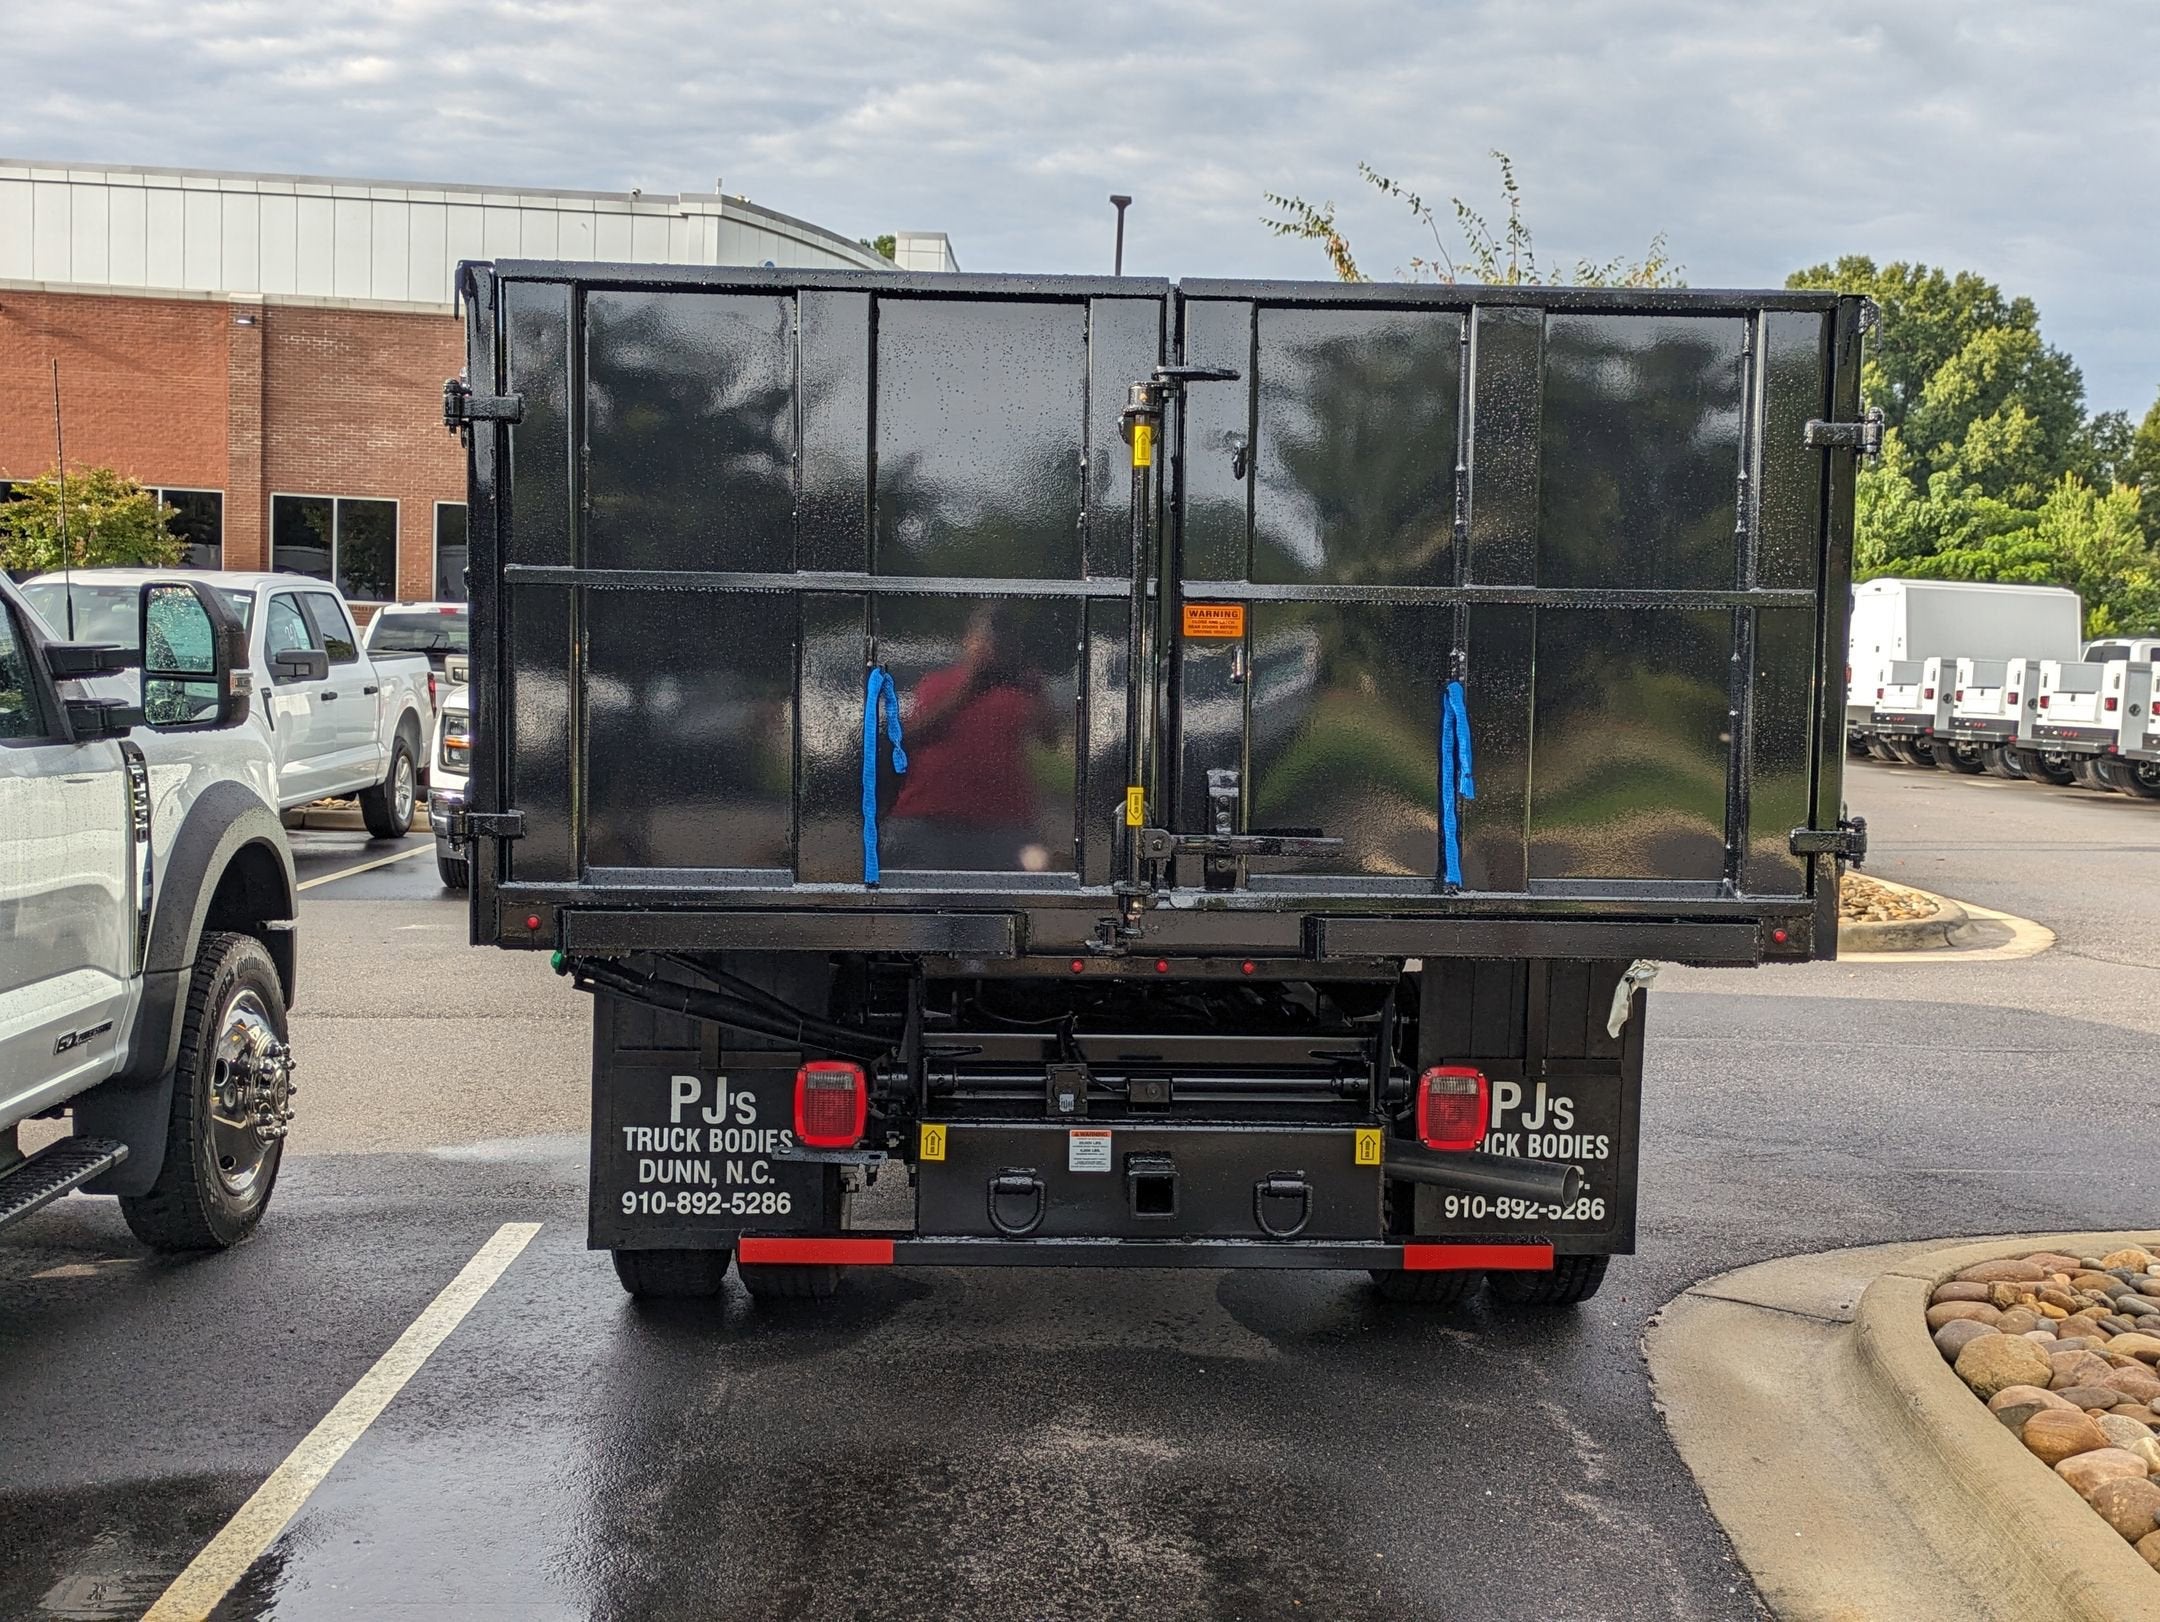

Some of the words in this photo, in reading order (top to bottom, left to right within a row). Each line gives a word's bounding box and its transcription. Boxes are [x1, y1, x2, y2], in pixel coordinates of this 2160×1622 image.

[1189, 610, 1239, 618] WARNING
[622, 1127, 701, 1152] TRUCK
[709, 1128, 793, 1154] BODIES
[1527, 1133, 1610, 1160] BODIES
[639, 1159, 718, 1189] DUNN,
[726, 1160, 776, 1185] N.C.
[621, 1192, 791, 1215] 910-892-5286
[1444, 1195, 1606, 1220] 910-892-5286
